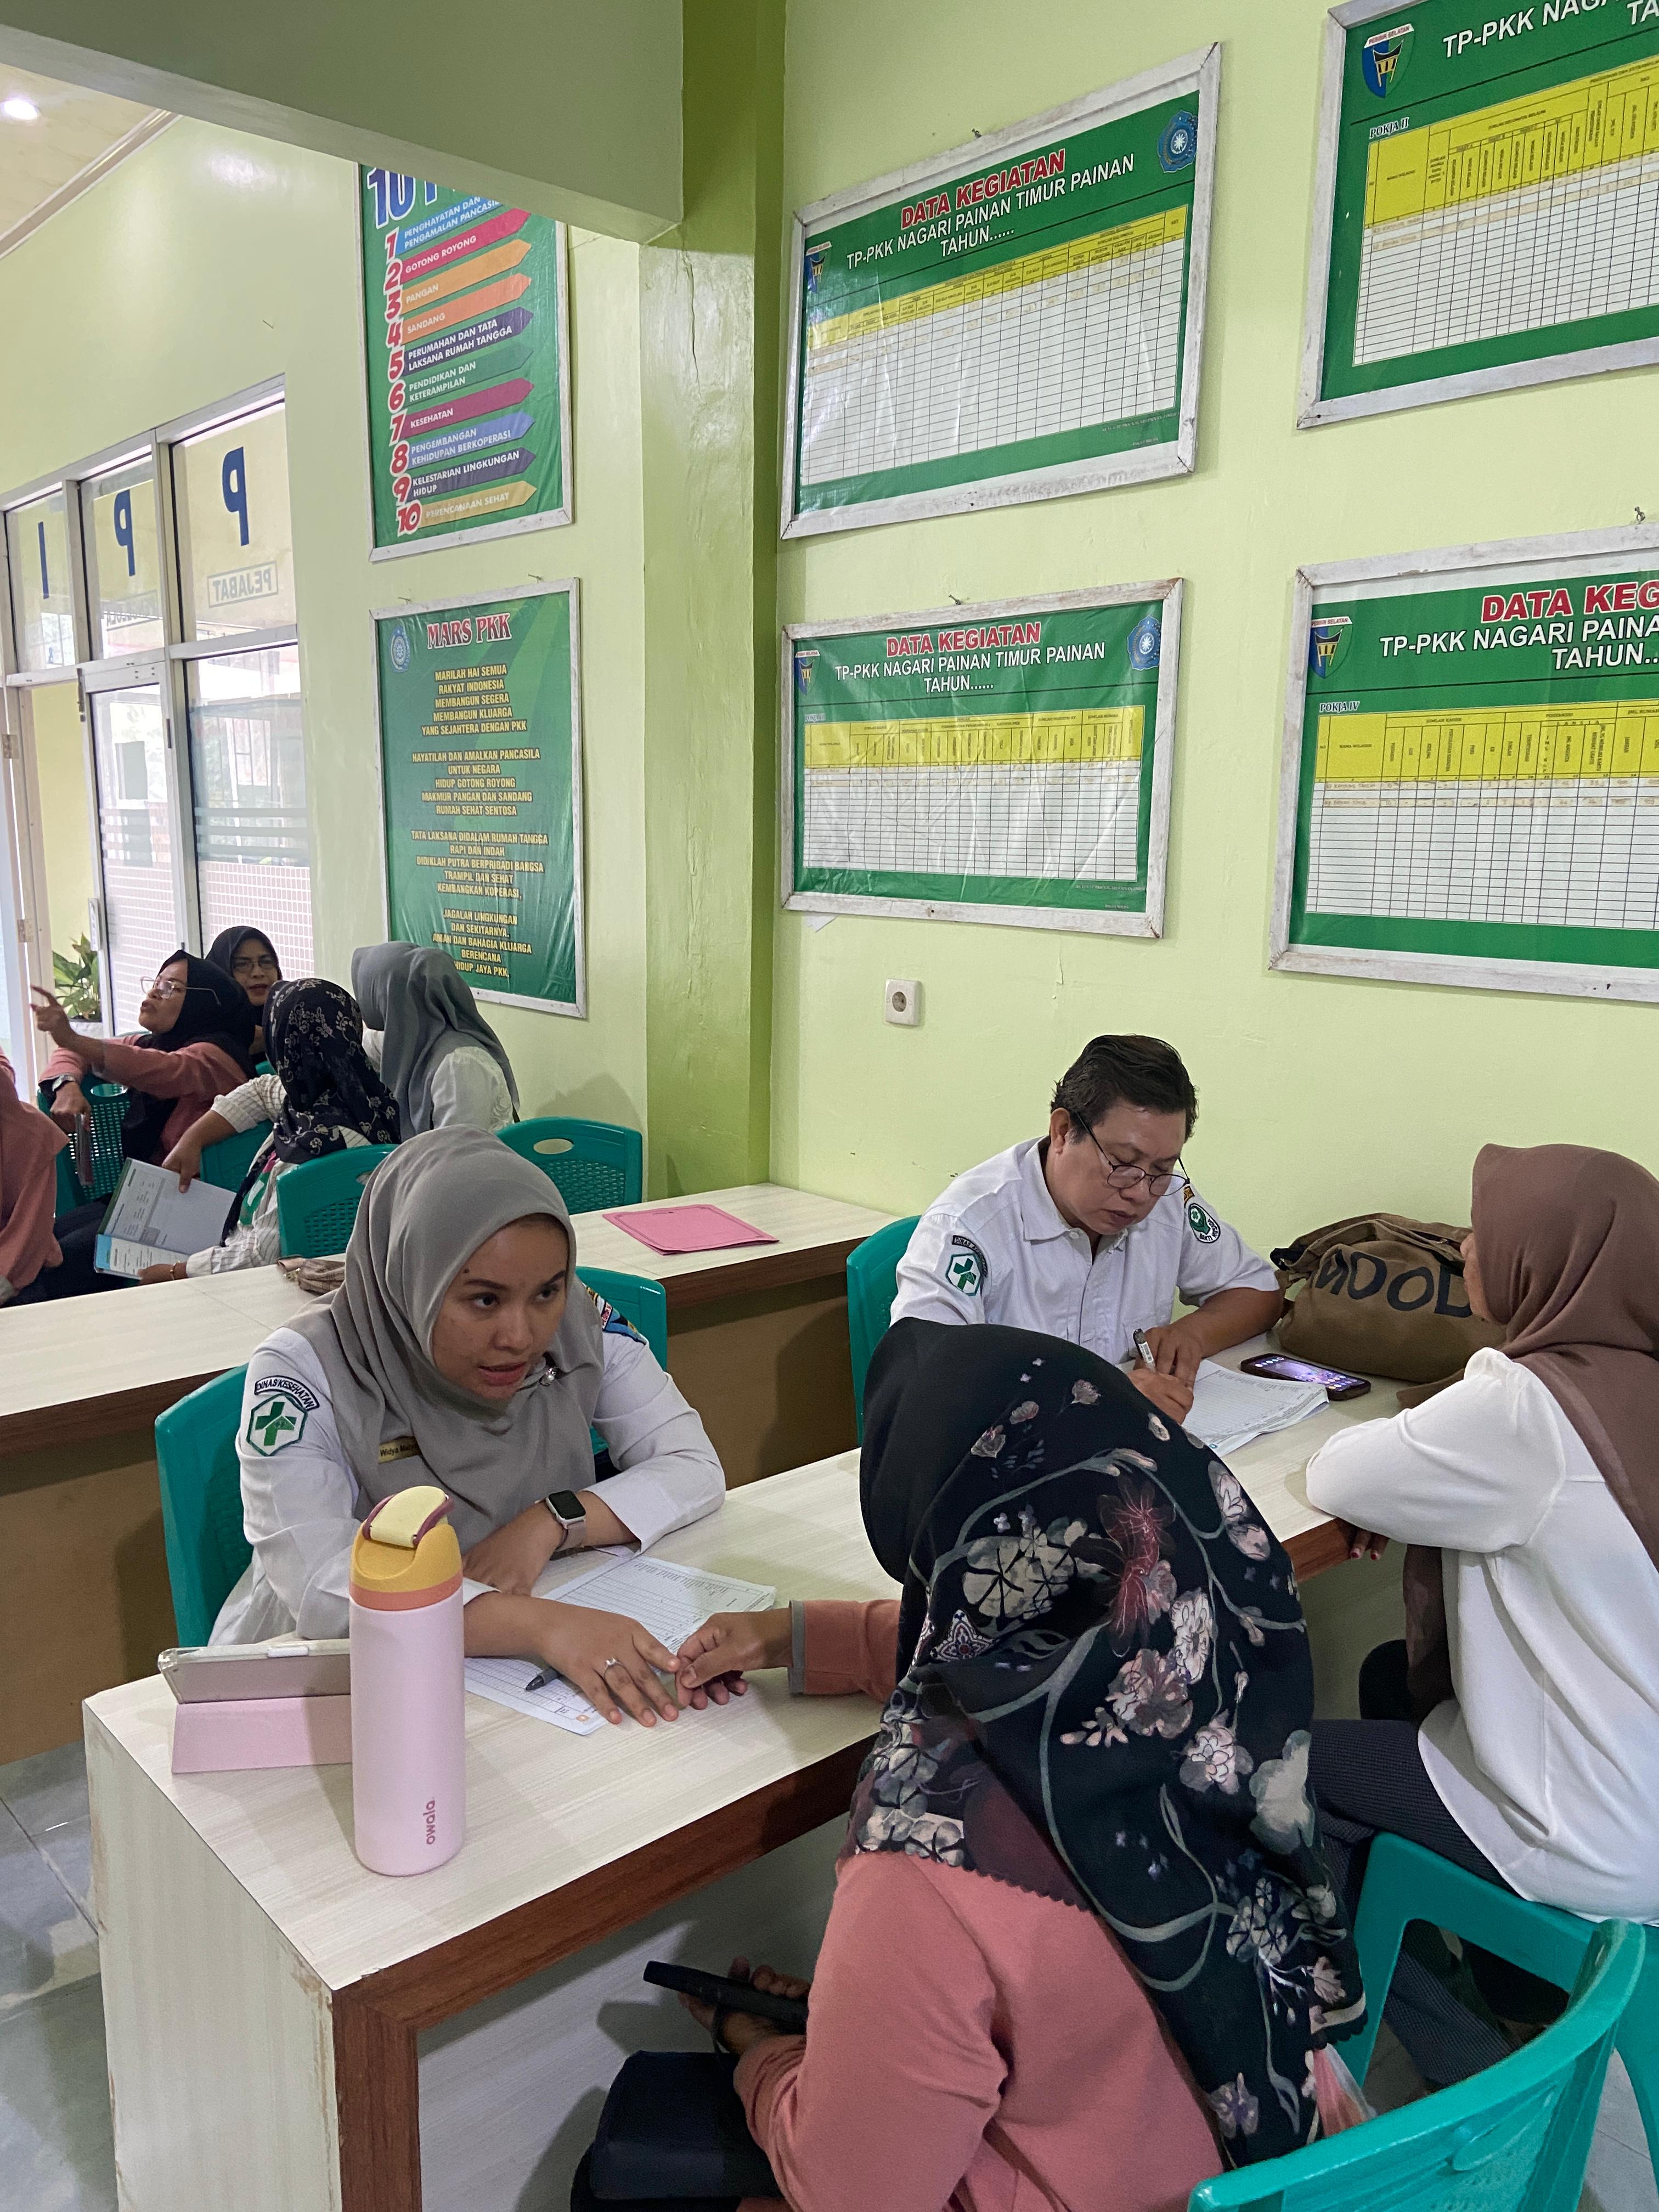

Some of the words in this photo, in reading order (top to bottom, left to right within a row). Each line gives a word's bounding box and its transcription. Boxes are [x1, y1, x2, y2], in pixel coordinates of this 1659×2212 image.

[1443, 8, 1534, 58] TP-PKK
[1369, 120, 1399, 139] POKJA
[900, 194, 950, 230] DATA
[956, 149, 1065, 211] KEGIATAN
[404, 205, 460, 238] PENGHAYATAN
[462, 197, 480, 211] DAN
[847, 239, 893, 270] TP-PKK
[897, 218, 951, 255] NAGARI
[956, 199, 1011, 239] PAINAN
[1015, 178, 1065, 211] TIMUR
[1071, 153, 1135, 192] PAINAN
[386, 229, 398, 262] 1
[405, 218, 458, 249] PENGAMALAN
[405, 253, 439, 273] GOTONG
[442, 235, 476, 257] ROYONG
[384, 259, 402, 293] 2
[386, 291, 402, 321] 3
[406, 285, 438, 303] PANGAN
[387, 320, 402, 348] 4
[408, 313, 445, 334] SANDANG
[408, 331, 456, 360] PERUMAHAN
[459, 328, 475, 341] DAN
[478, 319, 497, 333] TATA
[409, 353, 443, 371] LAKSANA
[445, 342, 474, 362] RUMAH
[477, 325, 512, 346] TANGGA
[389, 348, 403, 381] 5
[409, 369, 455, 391] PENDIDIKAN
[459, 362, 476, 375] DAN
[388, 381, 404, 411] 6
[410, 377, 465, 402] KETERAMPILAN
[391, 410, 406, 444] 7
[410, 409, 453, 428] KESEHATAN
[412, 429, 476, 454] PENGEMBANGAN
[412, 448, 455, 466] KEHIDUPAN
[458, 430, 511, 452] BERKOPERASI
[391, 442, 408, 473] 8
[413, 468, 460, 486] KELESTARIAN
[463, 451, 519, 471] LINGKUNGAN
[393, 475, 410, 504] 9
[413, 486, 437, 496] HIDUP
[397, 501, 421, 535] 10
[426, 499, 482, 518] PERENCANAAN
[484, 493, 509, 506] SEHAT
[1480, 588, 1572, 623] DATA
[427, 618, 472, 650] MARS
[476, 613, 512, 644] PKK
[886, 634, 934, 658] DATA
[938, 622, 1041, 652] KEGIATAN
[1380, 630, 1465, 657] TP-PKK
[1472, 621, 1573, 650] NAGARI
[435, 667, 466, 681] MARILAH
[467, 666, 479, 679] HAI
[482, 664, 506, 676] SEMUA
[836, 662, 879, 681] TP-PKK
[883, 658, 934, 677] NAGARI
[938, 653, 991, 674] PAINAN
[995, 647, 1042, 668] TIMUR
[1046, 642, 1105, 663] PAINAN
[439, 683, 465, 695] RAKYAT
[467, 679, 504, 692] INDONESIA
[435, 695, 479, 708] MEMBANGUN
[482, 693, 509, 705] SEGERA
[1319, 702, 1347, 713] POKJA
[1348, 701, 1360, 711] IV
[433, 709, 477, 722] MEMBANGUN
[479, 707, 512, 719] KLUARGA
[422, 726, 439, 736] YANG
[441, 723, 479, 735] SEJAHTERA
[481, 722, 510, 733] DENGAN
[511, 720, 527, 731] PKK
[413, 752, 447, 762] HAYATILAH
[449, 751, 462, 761] DAN
[464, 750, 498, 760] AMALKAN
[500, 748, 540, 760] PANCASILA
[448, 765, 471, 775] UNTUK
[472, 765, 500, 774] NEGARA
[436, 779, 455, 788] HIDUP
[458, 779, 484, 788] GOTONG
[487, 778, 515, 787] ROYONG
[422, 792, 451, 802] MAKMUR
[454, 792, 480, 802] PANGAN
[482, 792, 496, 802] DAN
[498, 792, 532, 802] SANDANG
[436, 805, 460, 815] RUMAH
[462, 805, 483, 815] SEHAT
[486, 806, 516, 815] SENTOSA
[411, 831, 426, 840] TATA
[428, 832, 457, 841] LAKSANA
[459, 832, 489, 842] DIDALAM
[492, 833, 517, 843] RUMAH
[520, 834, 548, 844] TANGGA
[450, 846, 466, 854] RAPI
[468, 847, 482, 855] DAN
[483, 847, 505, 856] INDAH
[417, 856, 445, 866] DIDIKLAH
[448, 858, 469, 867] PUTRA
[471, 860, 513, 870] BERPRIBADI
[515, 862, 544, 872] BANGSA
[444, 871, 474, 881] TRAMPIL
[476, 872, 489, 882] DAN
[492, 873, 514, 883] SEHAT
[437, 883, 483, 895] KEMBANGKAN
[485, 886, 522, 900] KOPERASI,
[444, 910, 473, 920] JAGALAH
[475, 912, 517, 924] LINGKUNGAN
[452, 923, 464, 932] DAN
[466, 924, 509, 937] SEKITARNYA.
[433, 934, 452, 943] AMAN
[454, 935, 466, 945] DAN
[469, 937, 498, 949] BAHAGIA
[500, 941, 532, 953] KLUARGA
[461, 950, 501, 962] BERENCANA
[454, 961, 473, 972] HIDUP
[476, 964, 491, 974] JAYA
[256, 1380, 276, 1390] DINAS
[278, 1380, 314, 1408] KESEHATAN
[422, 1799, 436, 1844] owala
